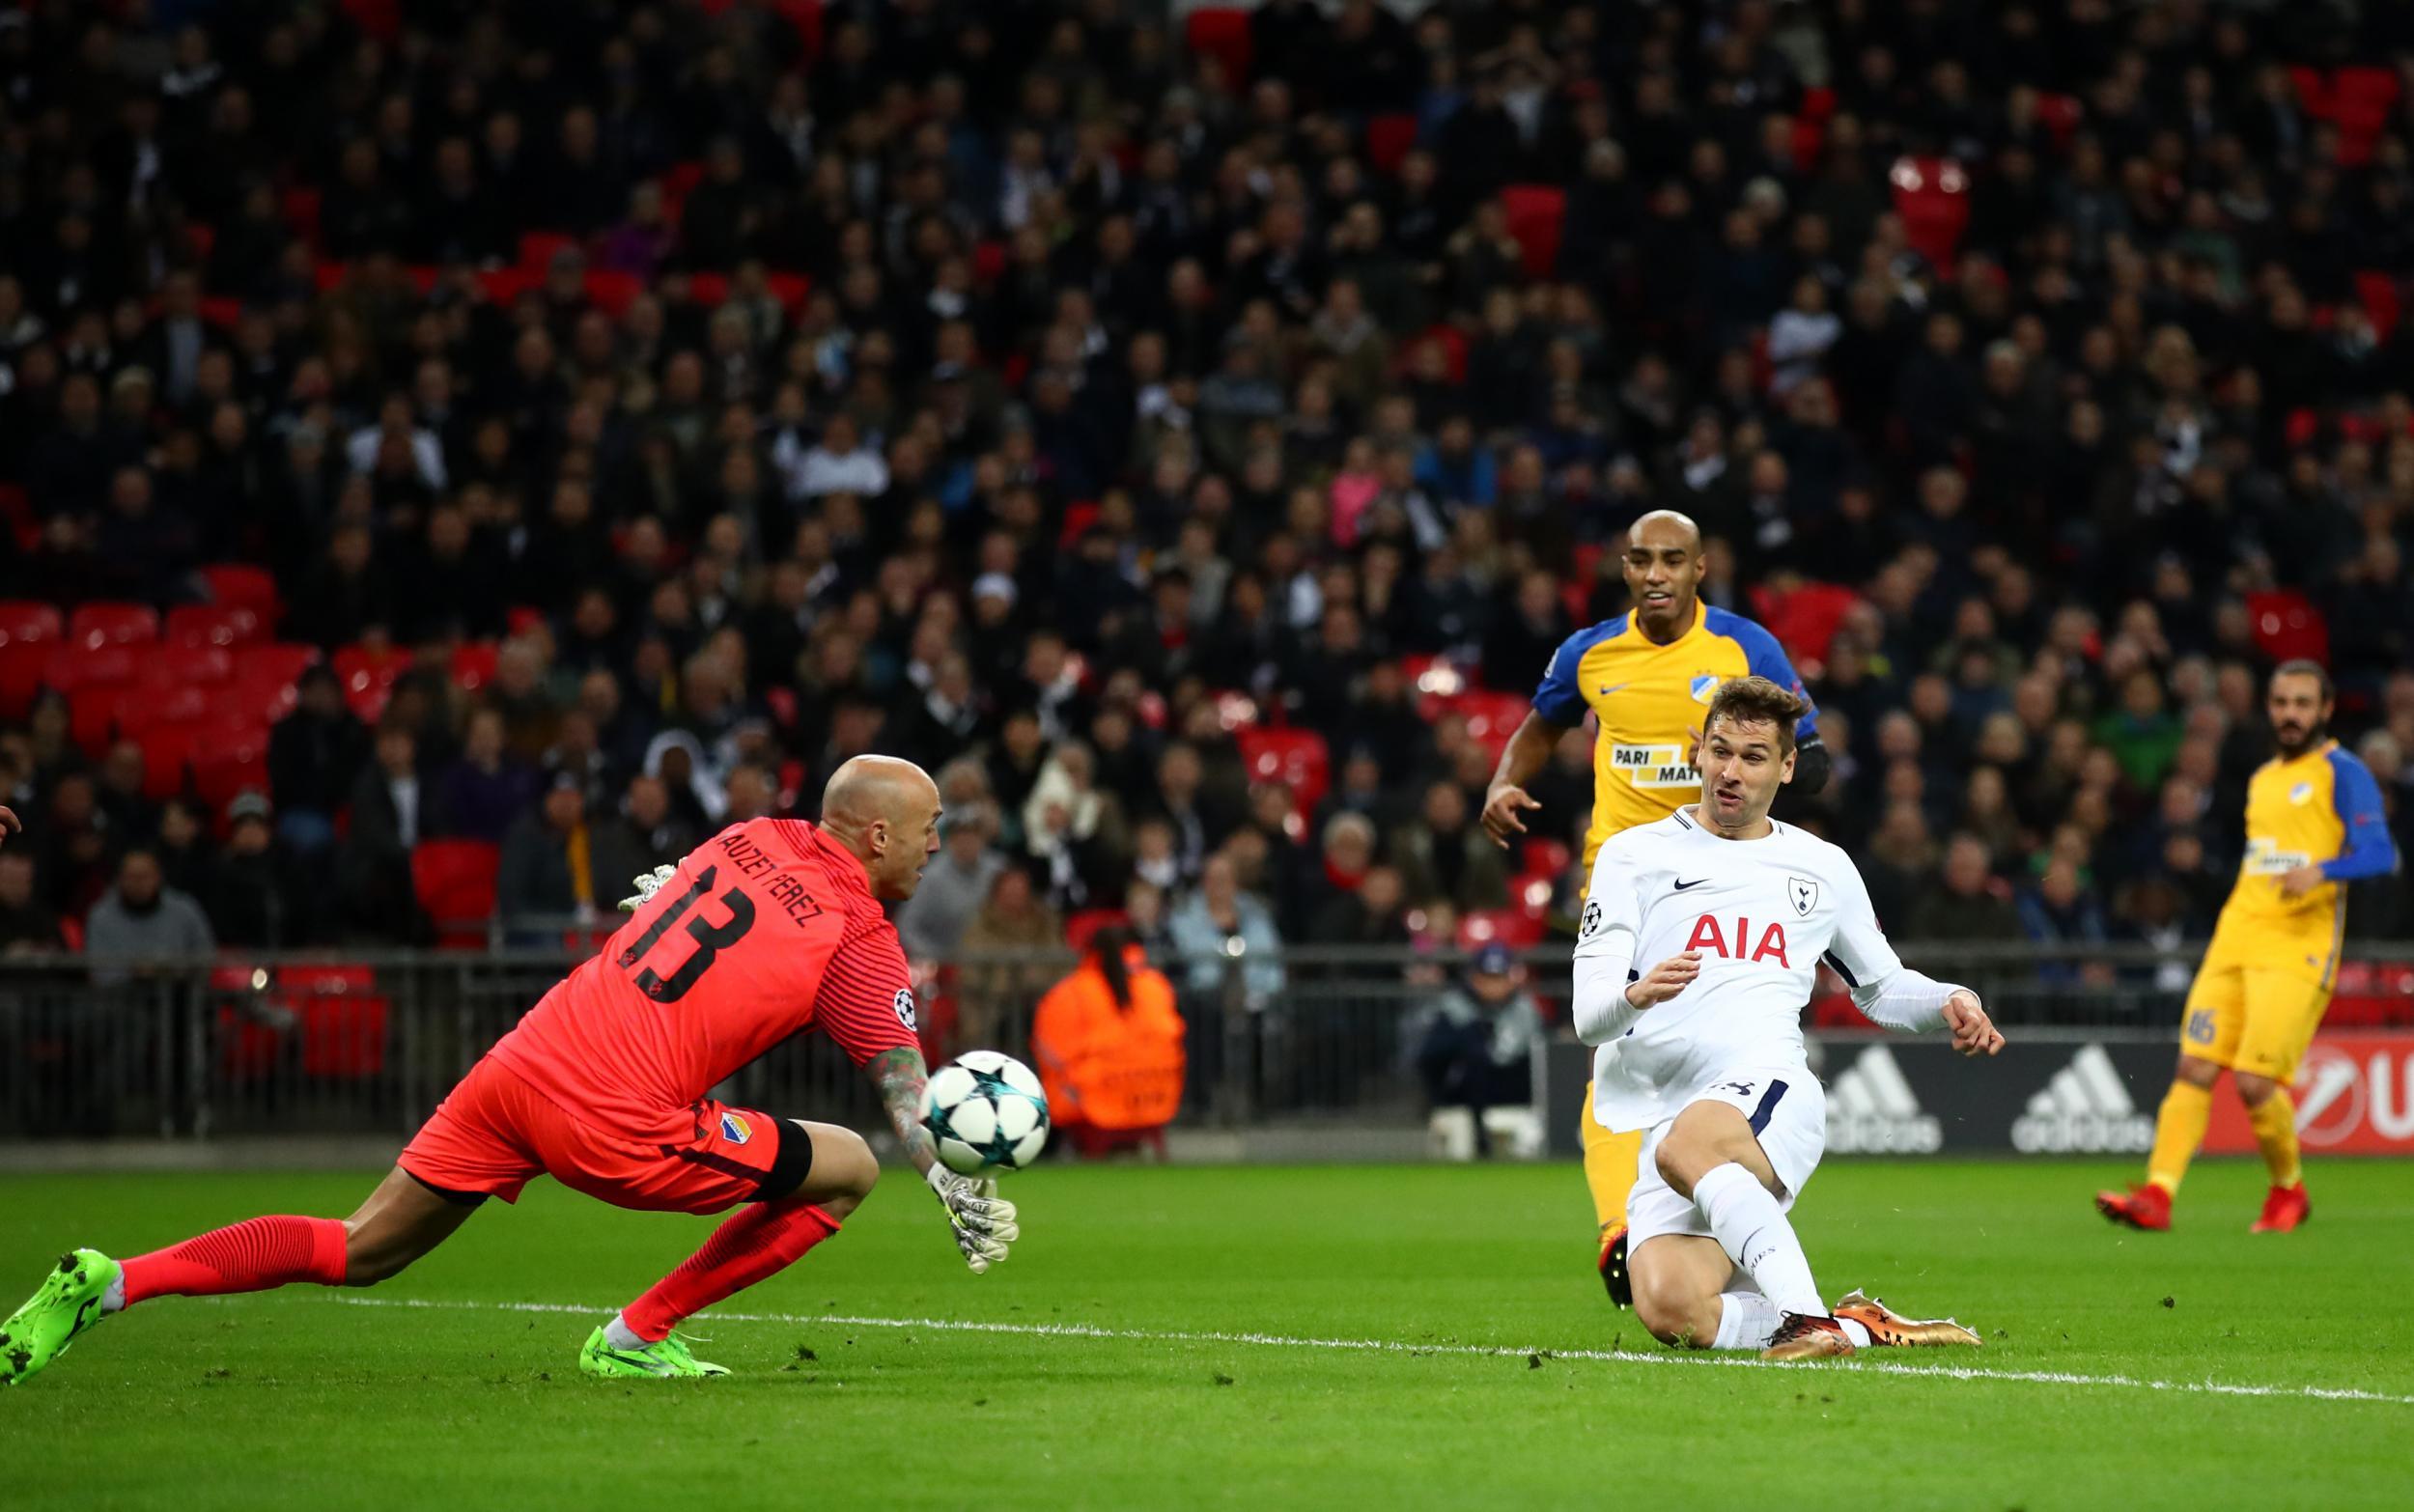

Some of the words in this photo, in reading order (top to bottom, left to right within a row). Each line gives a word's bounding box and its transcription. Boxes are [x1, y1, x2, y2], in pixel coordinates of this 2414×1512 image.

[1615, 750, 1649, 765] PARI
[1659, 767, 1701, 781] MAT
[762, 874, 823, 928] PEREZ
[616, 864, 755, 1003] 13
[1685, 914, 1790, 969] AIA
[1825, 1113, 1943, 1153] didas
